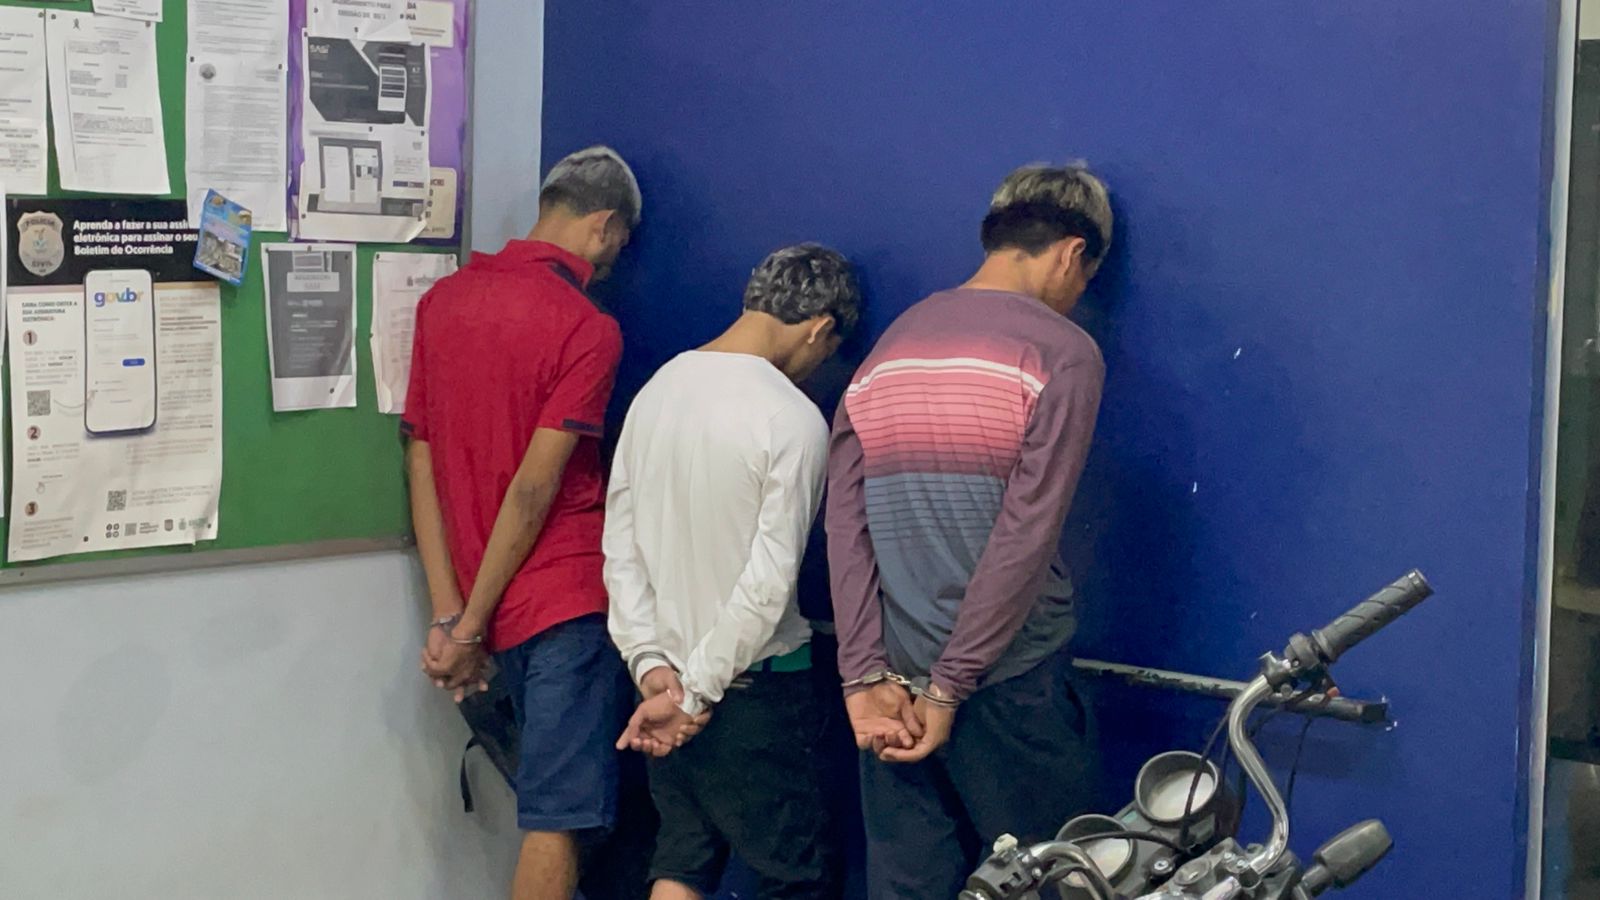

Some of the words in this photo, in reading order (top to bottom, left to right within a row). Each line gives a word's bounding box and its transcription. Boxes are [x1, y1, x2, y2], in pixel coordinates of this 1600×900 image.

[73, 219, 113, 233] Aprenda
[114, 221, 120, 230] a
[122, 219, 144, 230] fazer
[145, 221, 151, 230] a
[152, 221, 168, 230] sua
[73, 232, 120, 243] eletrônica
[121, 234, 142, 244] para
[143, 232, 173, 242] assinar
[175, 233, 182, 241] o
[182, 233, 198, 241] seu
[74, 244, 109, 255] Boletim
[110, 245, 123, 255] de
[125, 244, 174, 255] Ocorrência
